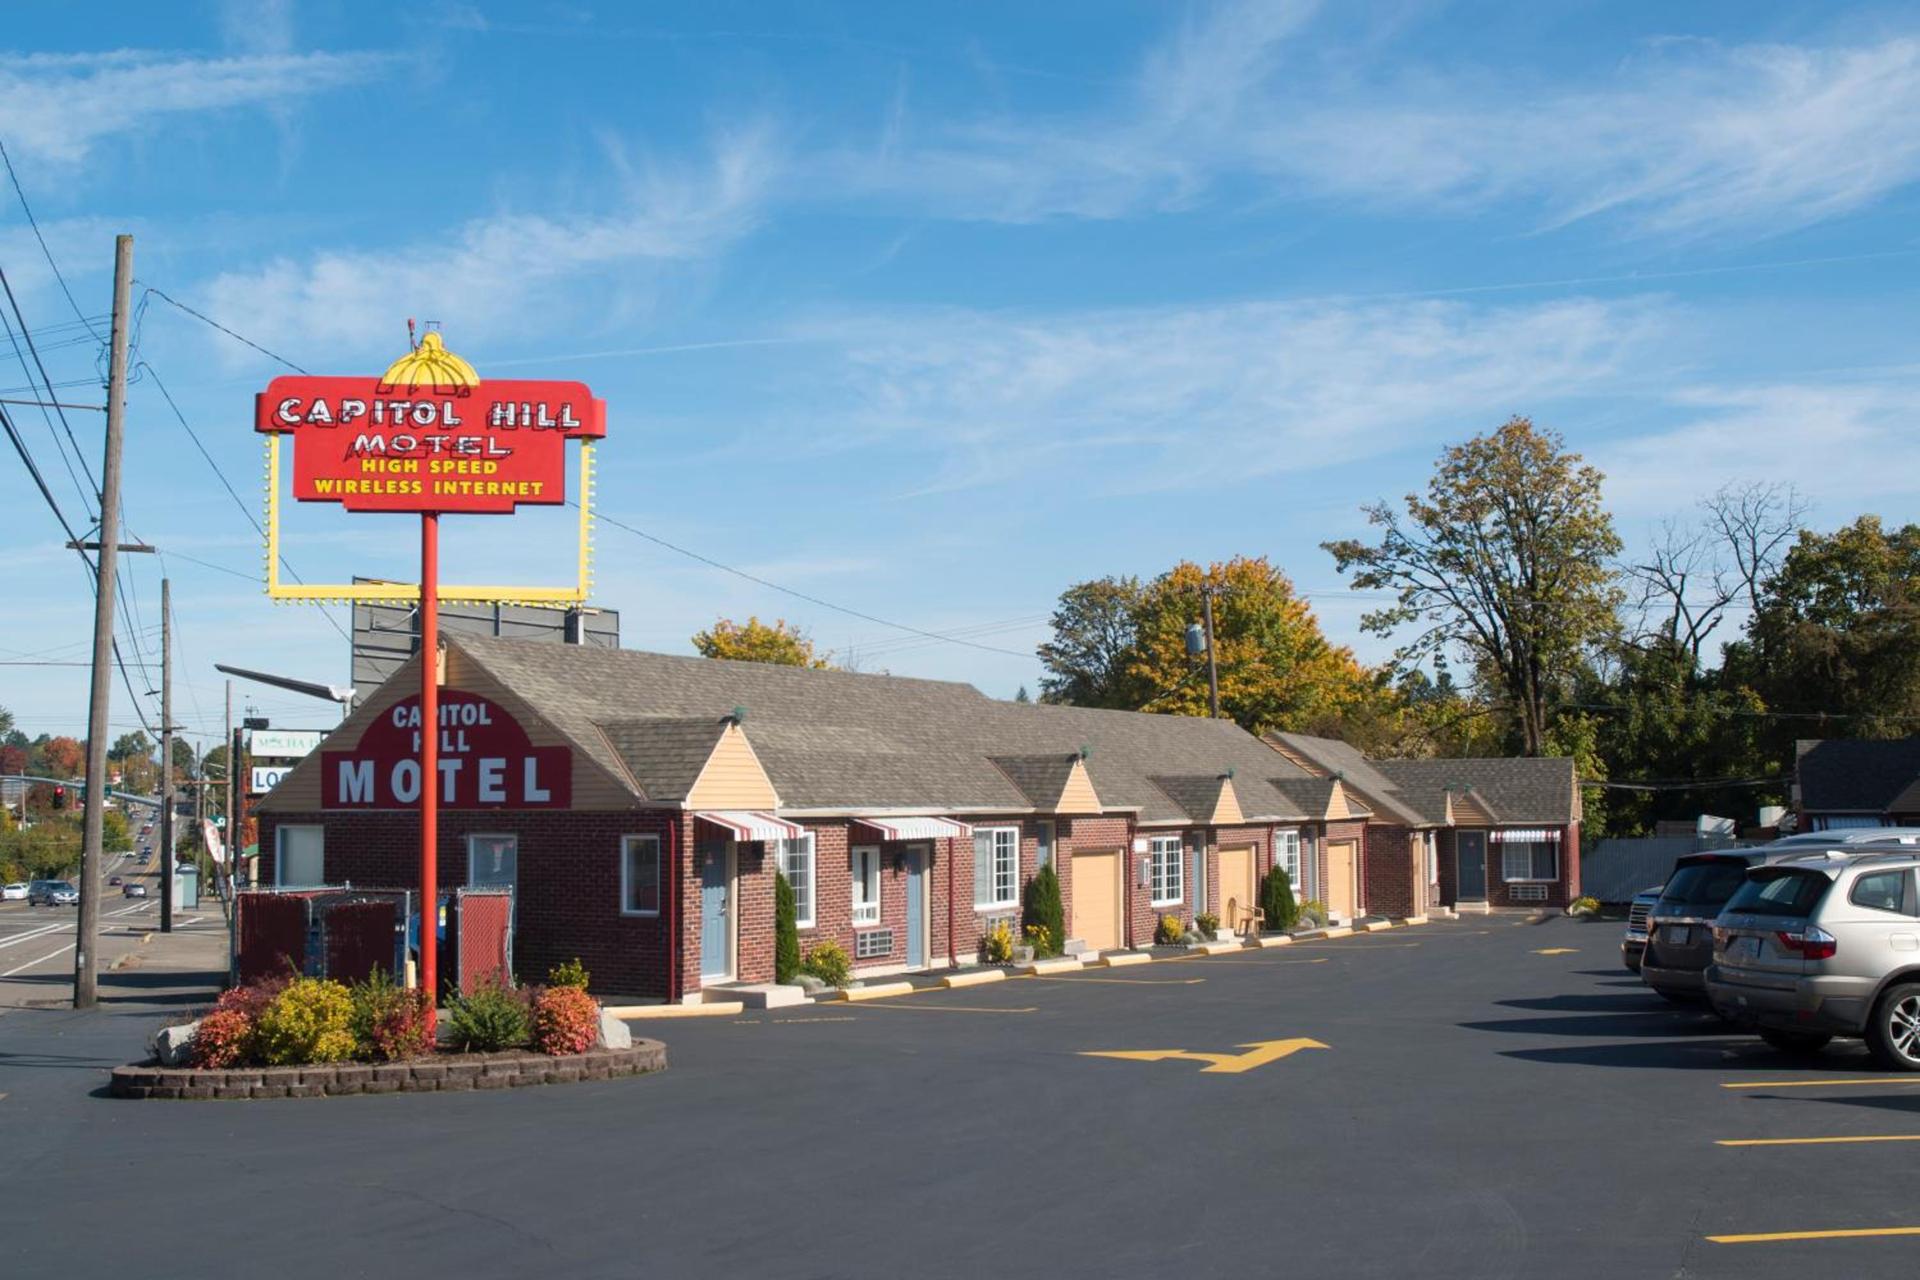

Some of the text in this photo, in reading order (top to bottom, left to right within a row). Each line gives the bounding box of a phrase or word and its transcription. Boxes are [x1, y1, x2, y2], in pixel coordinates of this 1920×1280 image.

[278, 398, 581, 428] CAPITOL HILL
[353, 432, 512, 456] MOTEL
[361, 459, 498, 474] HIGH SPEED
[314, 479, 544, 495] WIRELESS INTERNET
[392, 703, 492, 728] CAITOL
[413, 730, 471, 753] HLL
[338, 757, 551, 803] MOTEL
